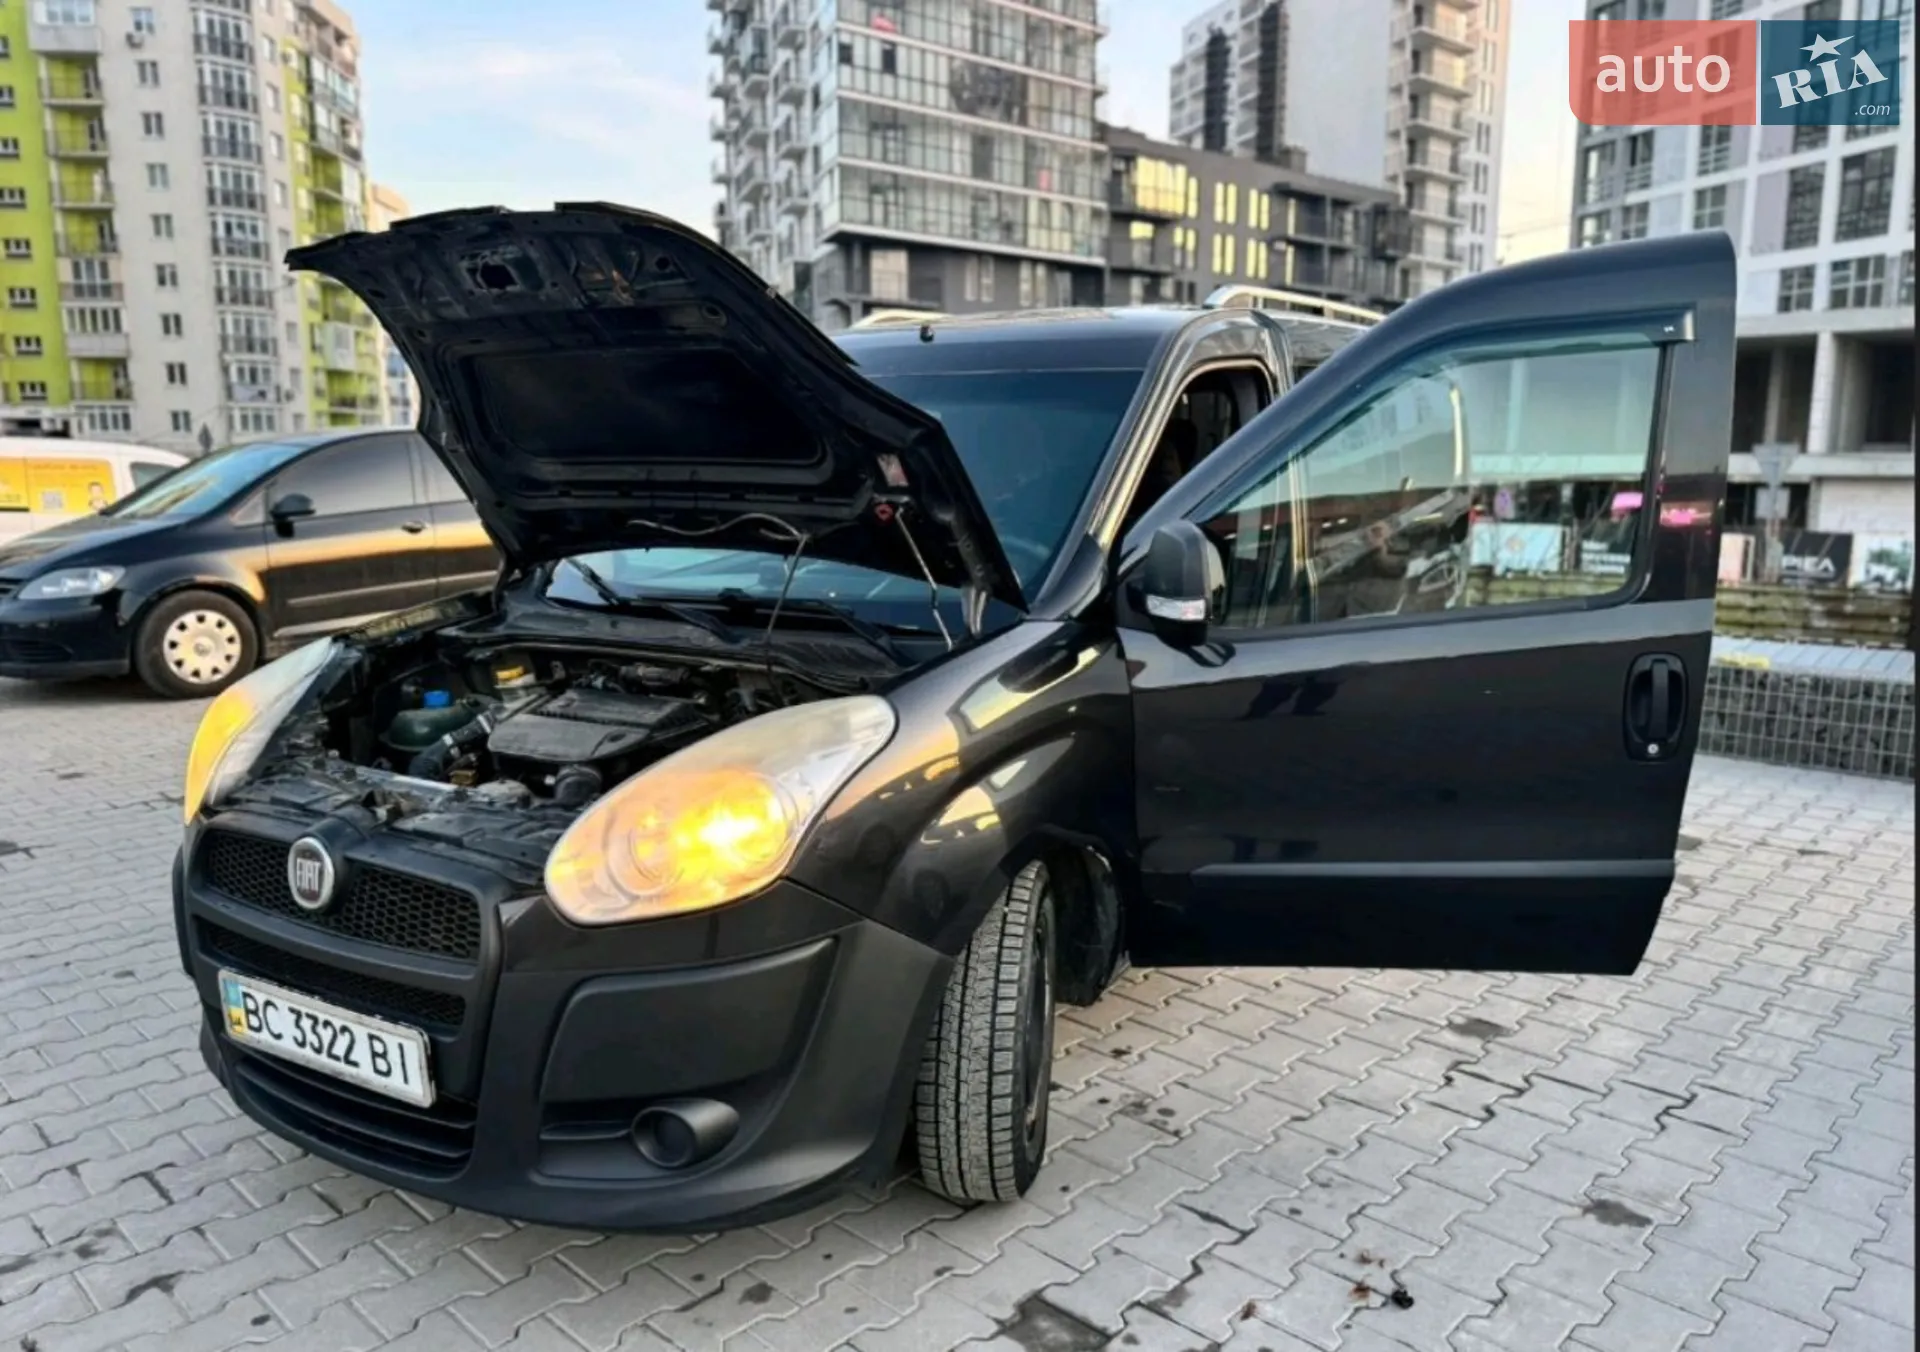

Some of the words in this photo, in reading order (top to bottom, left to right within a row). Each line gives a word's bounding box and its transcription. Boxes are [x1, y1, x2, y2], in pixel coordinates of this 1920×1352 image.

[296, 857, 321, 891] FIAT
[241, 991, 283, 1040] BC
[287, 1008, 360, 1068] 3322
[368, 1033, 409, 1085] BI
